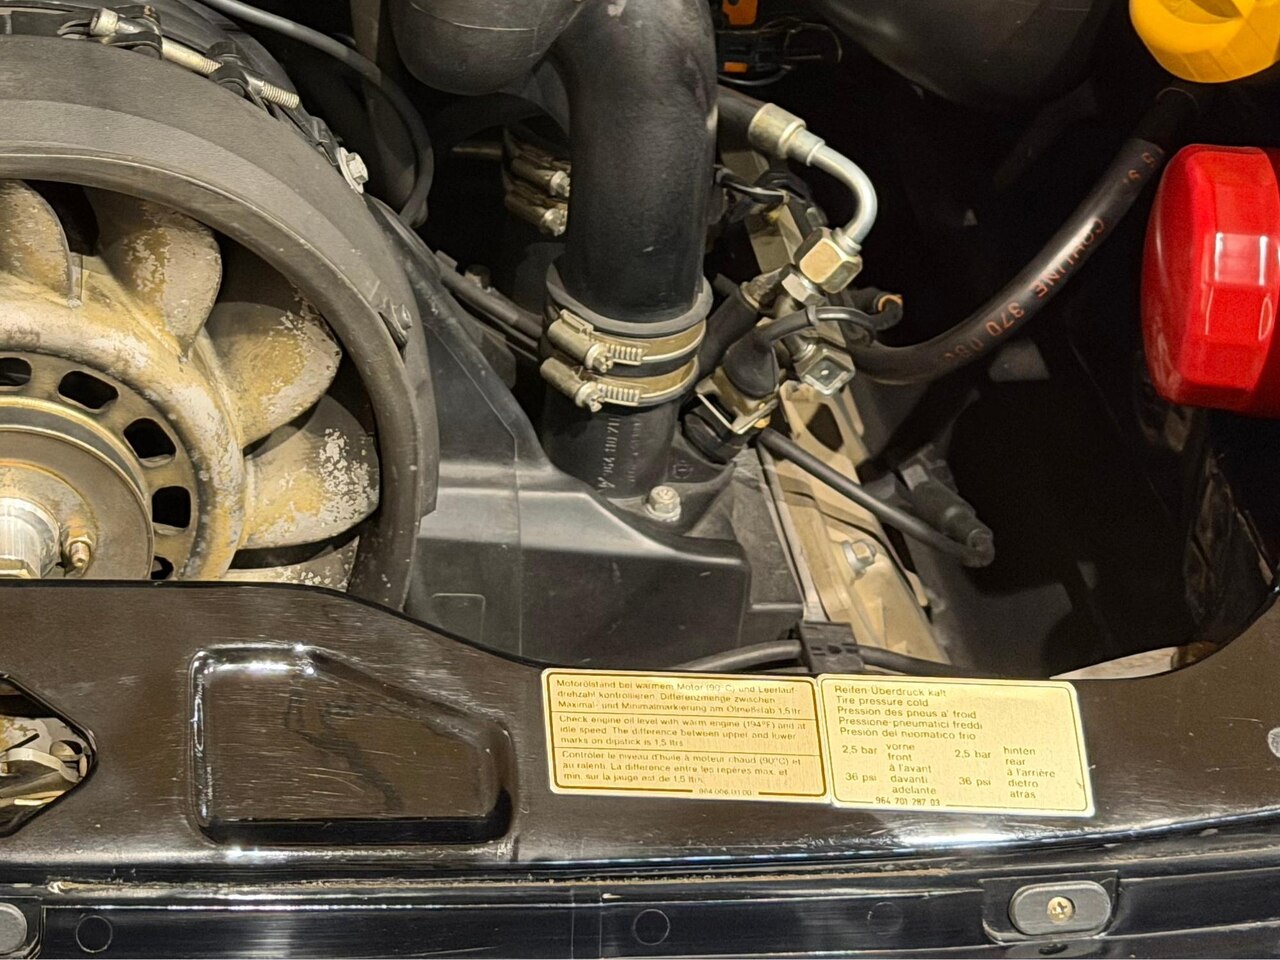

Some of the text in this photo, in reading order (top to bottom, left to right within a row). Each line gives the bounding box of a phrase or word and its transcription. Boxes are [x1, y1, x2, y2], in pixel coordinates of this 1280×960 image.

[837, 696, 855, 704] Tire
[859, 698, 903, 706] pressure
[838, 706, 880, 715] Pression
[885, 708, 902, 716] des
[953, 710, 976, 719] froid
[560, 715, 587, 723] Check
[591, 717, 620, 725] engine
[638, 717, 658, 725] level
[953, 720, 982, 730] freddi
[632, 728, 677, 736] difference
[882, 728, 897, 737] del
[606, 737, 640, 746] dipstick
[861, 746, 877, 754] bar
[886, 743, 915, 751] vorne
[975, 750, 991, 758] bar
[1003, 746, 1035, 756] hinten
[888, 752, 912, 761] front
[1005, 758, 1025, 766] rear
[845, 772, 928, 784] 36 psi davanti
[959, 777, 1039, 788] 36 psi dietro
[892, 785, 936, 794] adelante
